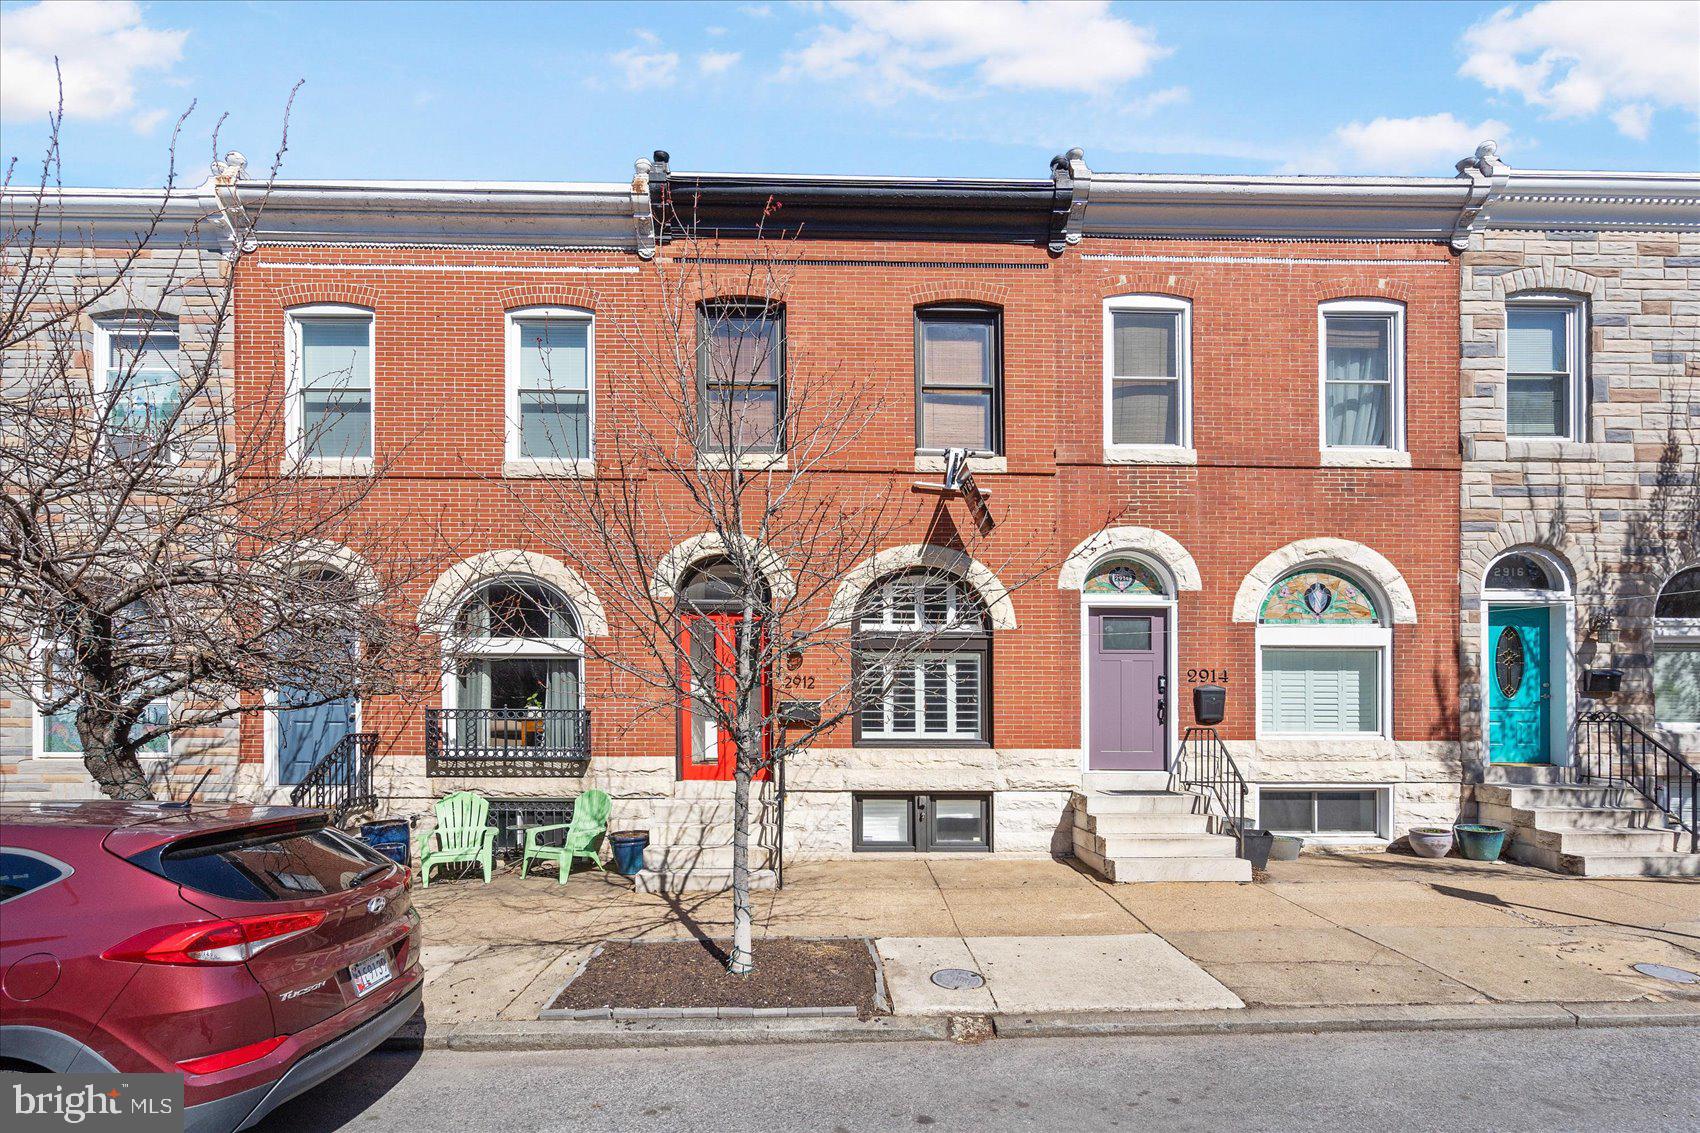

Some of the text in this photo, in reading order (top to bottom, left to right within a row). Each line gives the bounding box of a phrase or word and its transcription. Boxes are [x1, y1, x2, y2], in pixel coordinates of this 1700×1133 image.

[1494, 567, 1524, 577] 2916
[784, 675, 815, 689] 2912
[1187, 669, 1229, 683] 2914
[279, 980, 326, 1002] TUCSON
